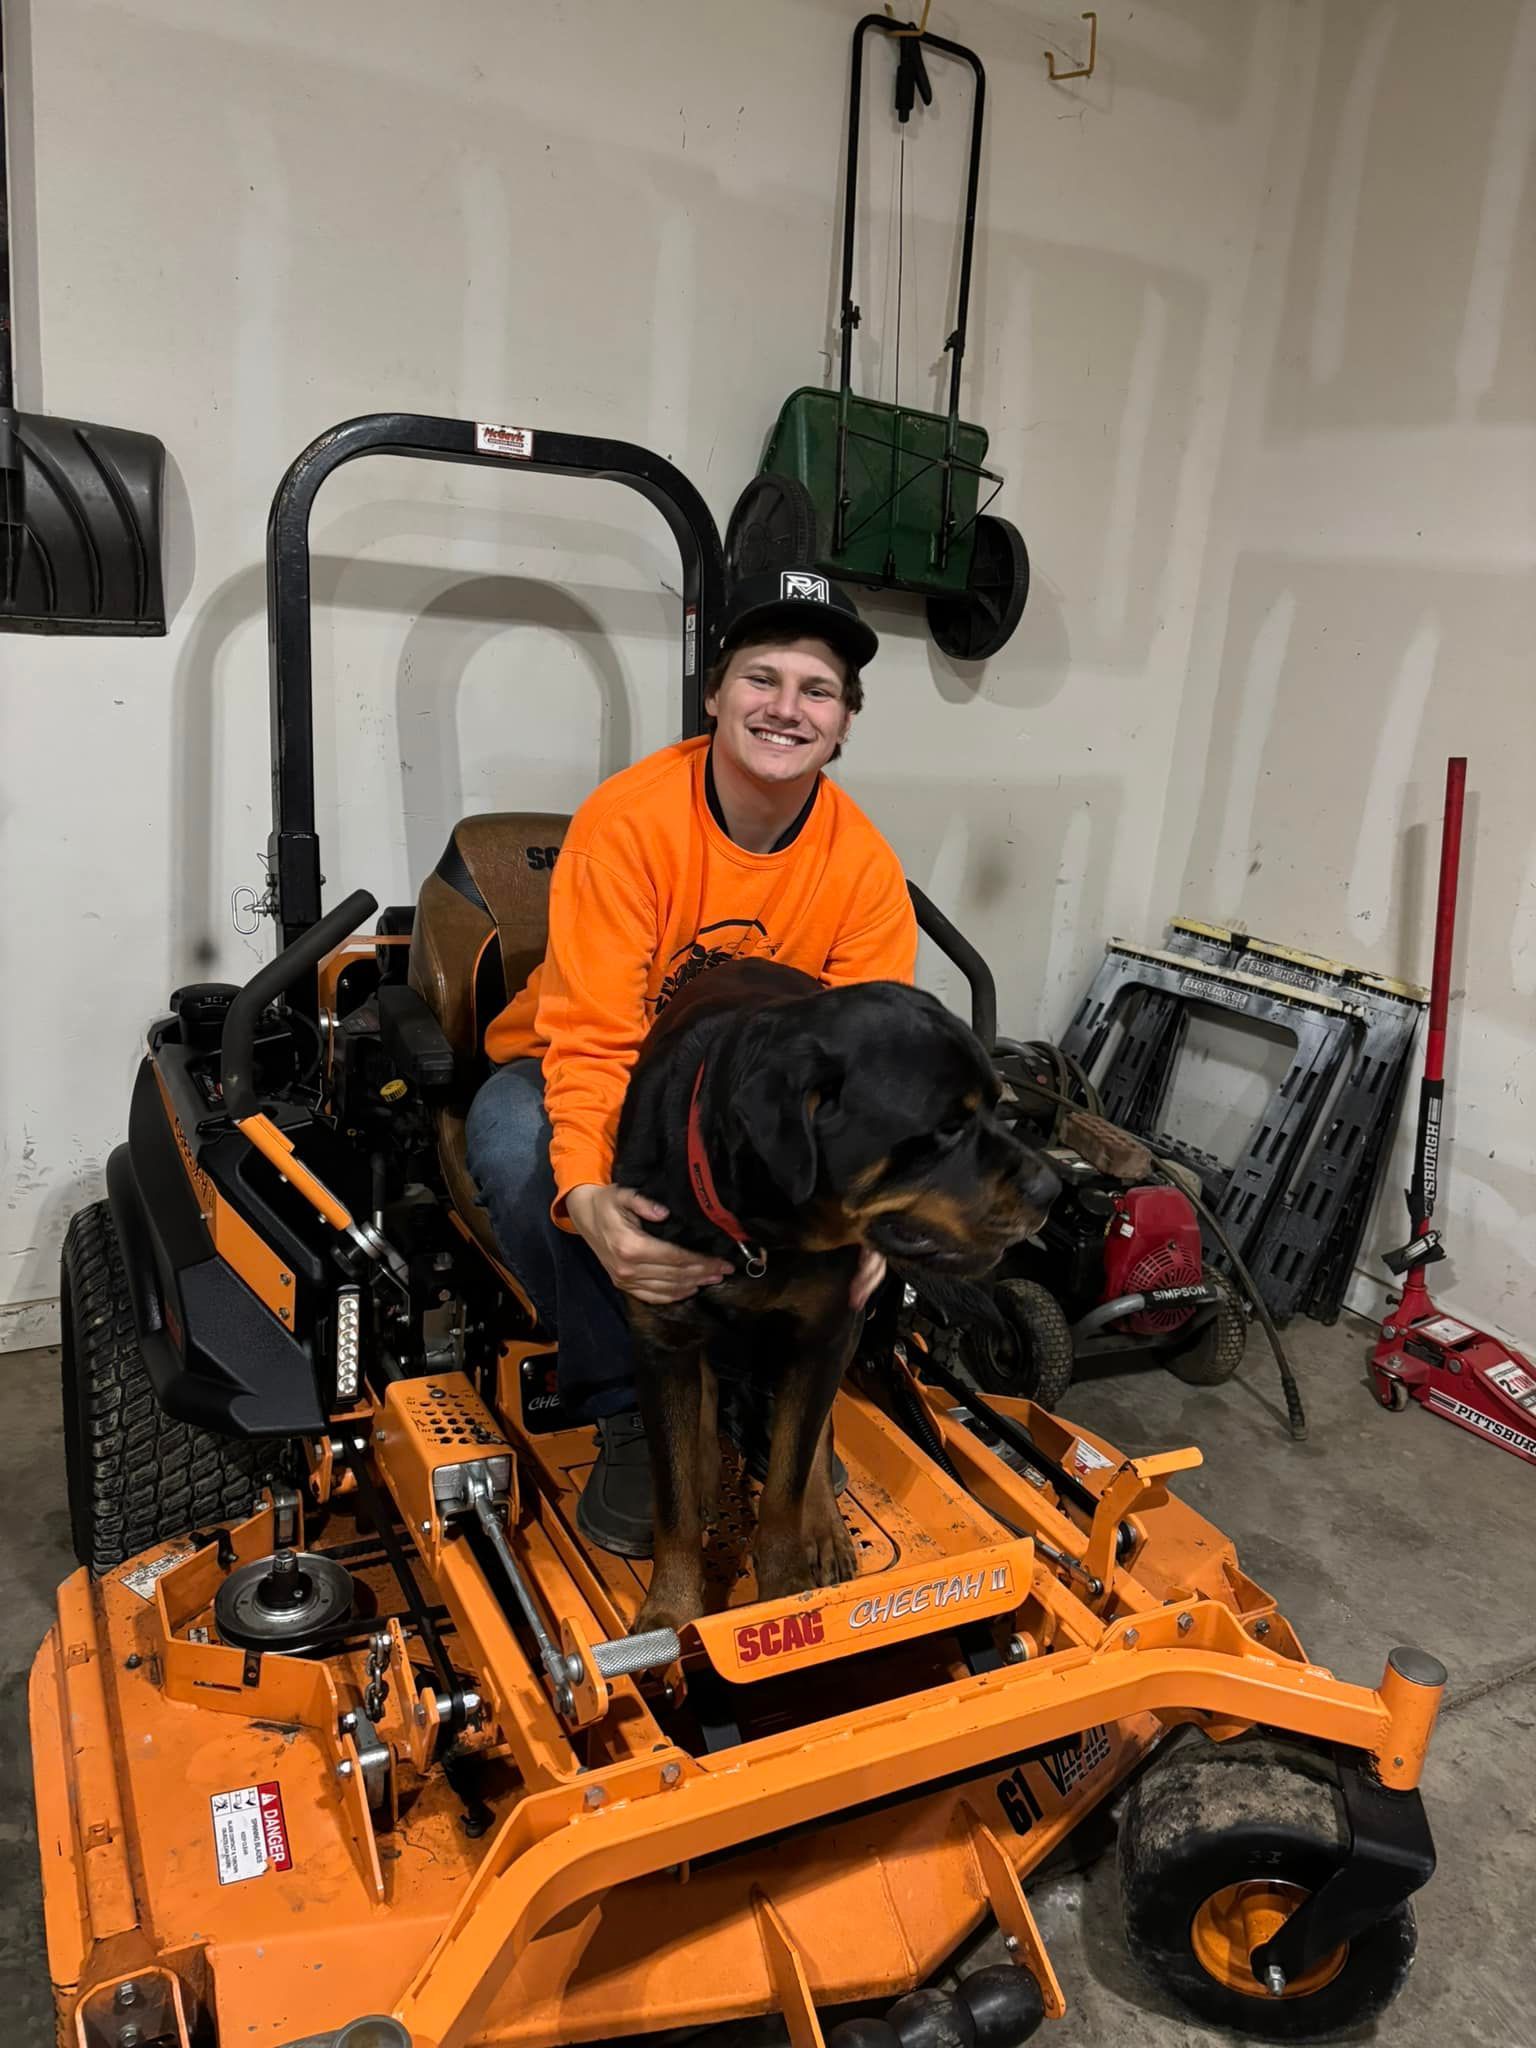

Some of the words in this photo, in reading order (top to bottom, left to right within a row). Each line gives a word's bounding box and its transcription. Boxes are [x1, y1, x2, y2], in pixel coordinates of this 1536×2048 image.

[1152, 1285, 1207, 1301] SIMPSON
[1498, 1378, 1519, 1395] 2
[737, 1609, 825, 1663] SCAG
[848, 1570, 985, 1629] CHEETAH
[996, 1767, 1044, 1836] 61
[263, 1809, 286, 1863] DANGER
